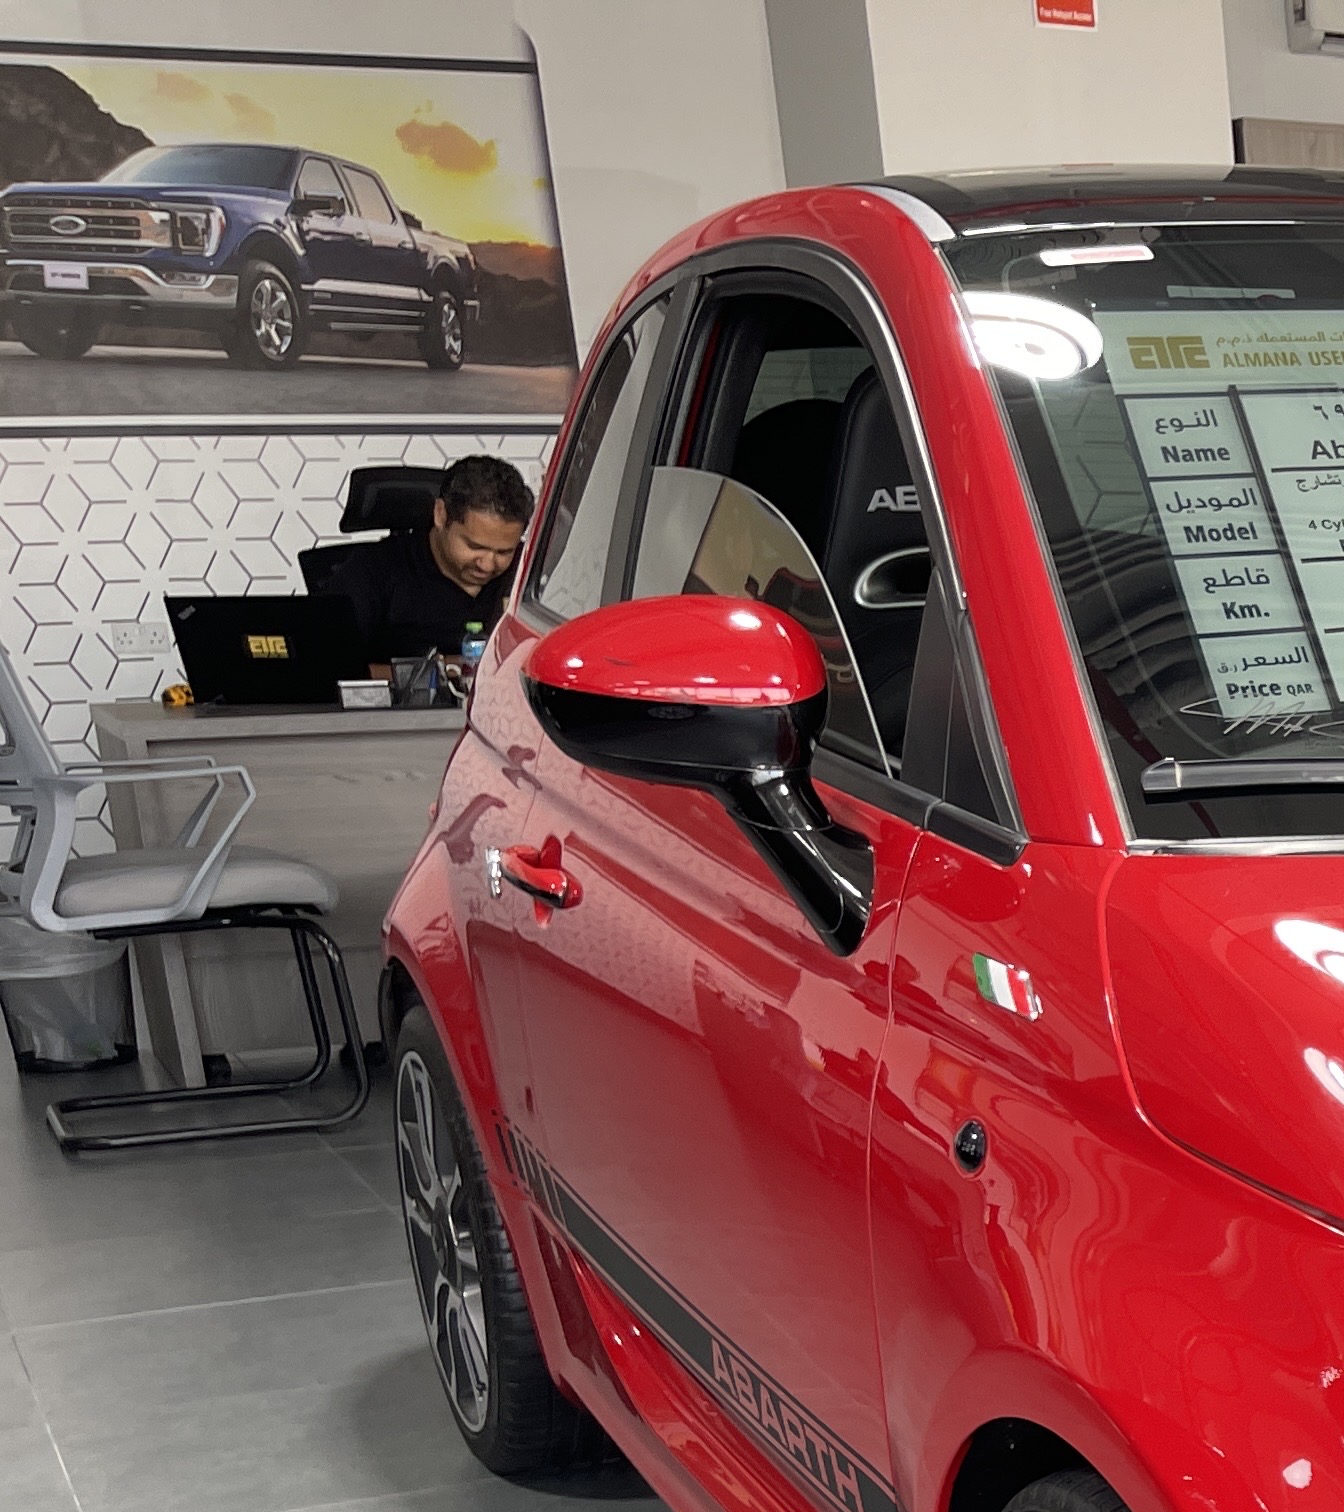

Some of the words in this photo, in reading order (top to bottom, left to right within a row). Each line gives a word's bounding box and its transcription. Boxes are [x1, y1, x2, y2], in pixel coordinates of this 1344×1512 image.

[1223, 351, 1303, 368] ALMANA
[1160, 445, 1231, 463] Name
[1165, 487, 1258, 513] الموديل
[1183, 521, 1259, 543] Model
[1308, 519, 1318, 531] 4
[1202, 566, 1271, 594] قاطع
[1221, 601, 1271, 620] Km.
[1242, 645, 1309, 672] السعر
[1225, 680, 1282, 700] Price
[1286, 683, 1314, 697] QAR
